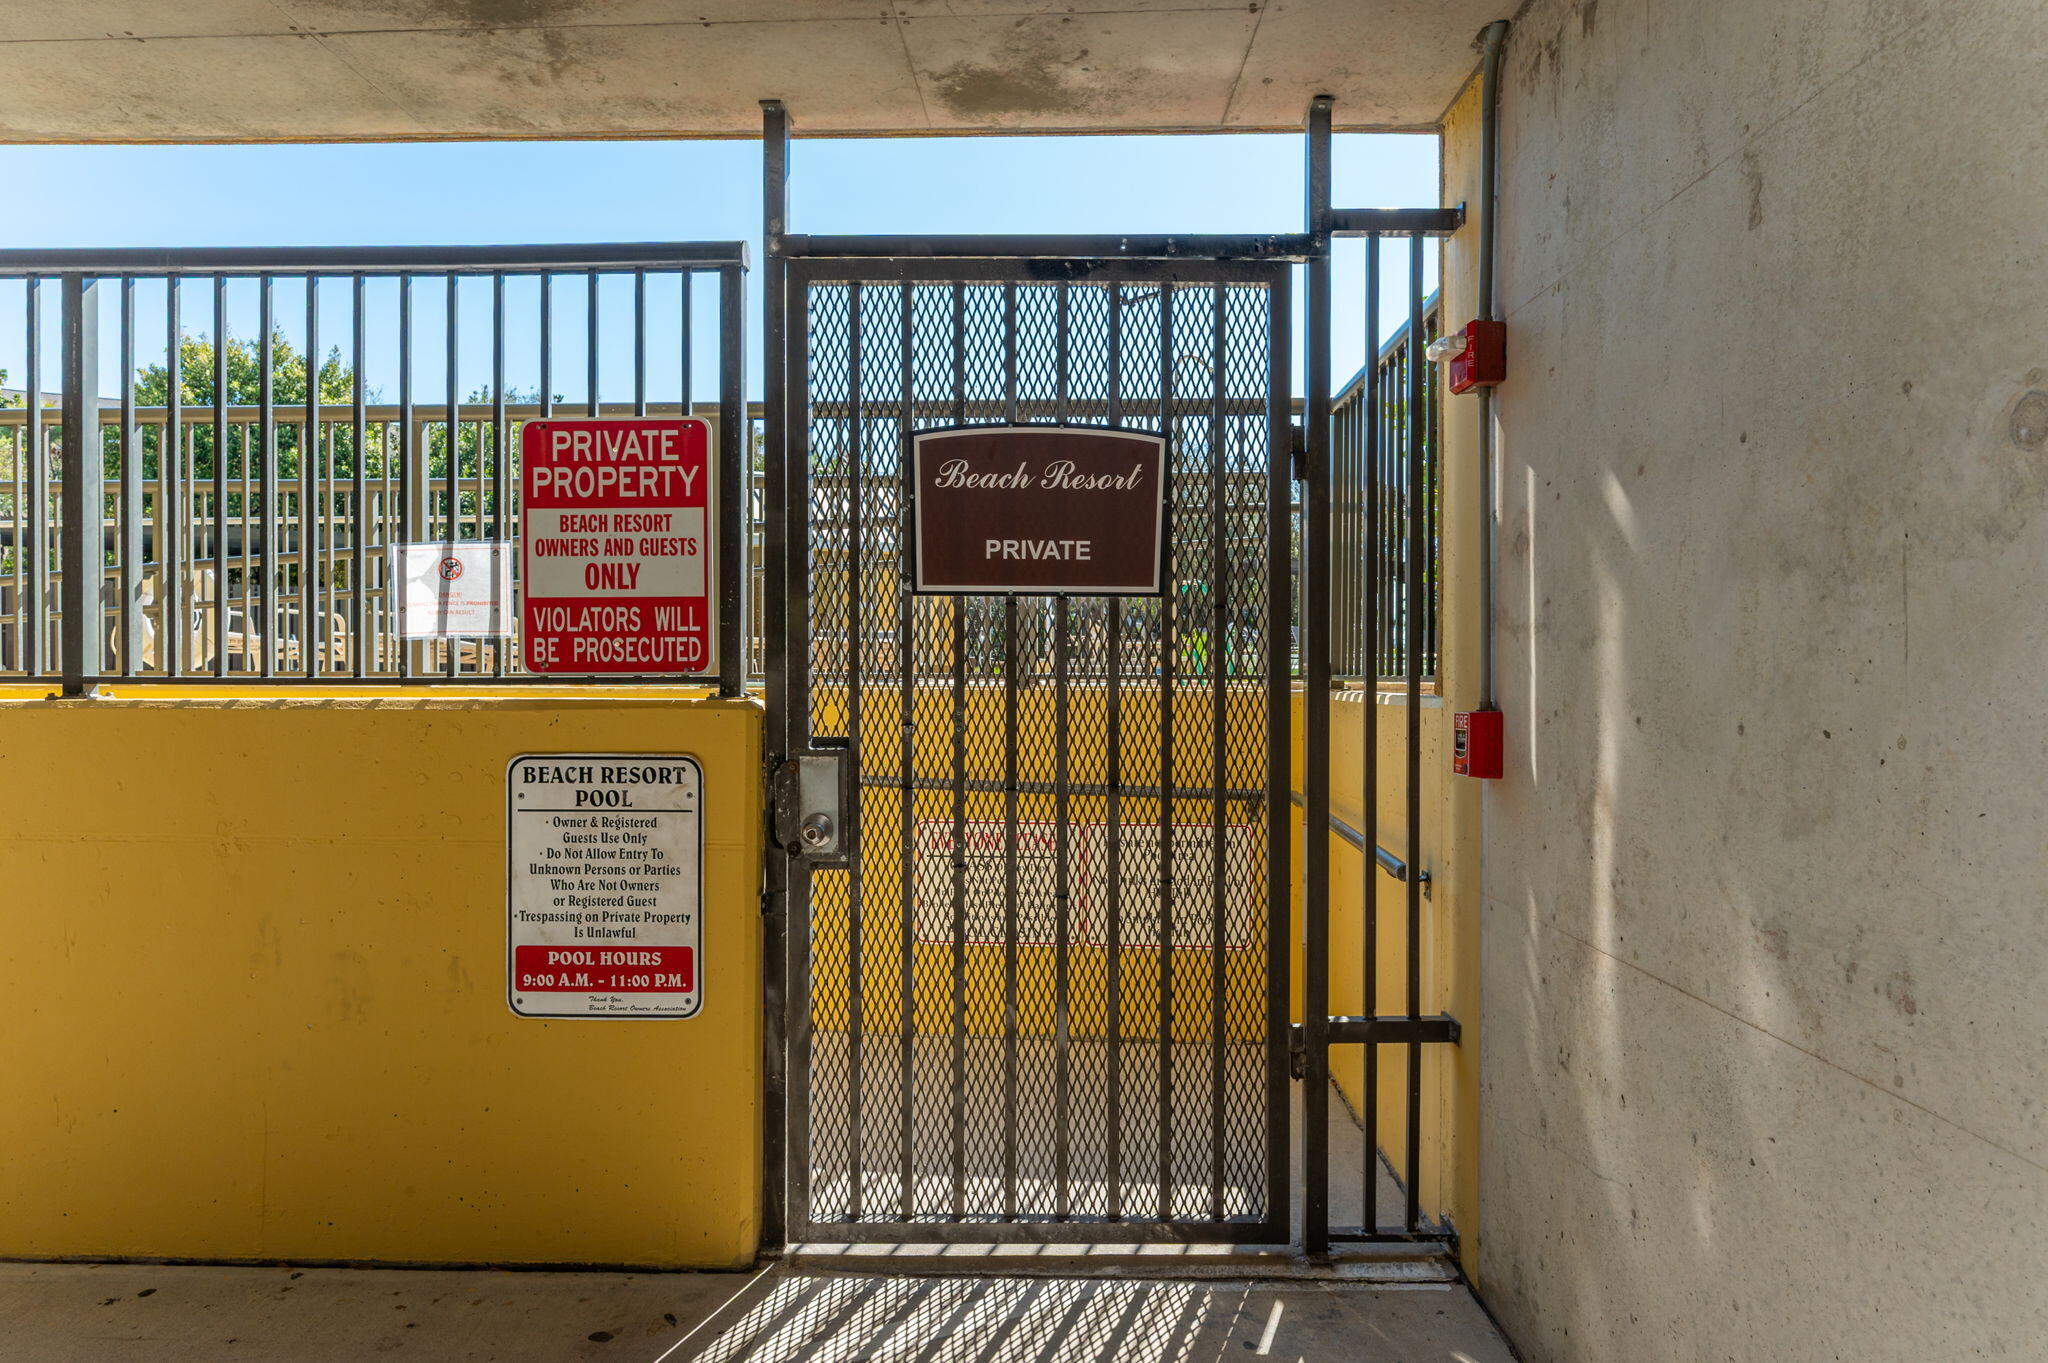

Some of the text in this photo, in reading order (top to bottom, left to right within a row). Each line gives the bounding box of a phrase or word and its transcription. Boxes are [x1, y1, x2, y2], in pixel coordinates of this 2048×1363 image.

[552, 430, 679, 461] PRIVATE
[533, 466, 699, 498] PROPERTY
[935, 458, 1142, 490] Beach Resort
[560, 514, 672, 533] BEACH RESORT
[535, 537, 697, 557] OWNERS AND GUESTS
[986, 540, 1091, 560] PRIVATE
[585, 563, 640, 590] ONLY
[534, 606, 701, 632] VIOLATORS WILL
[534, 637, 701, 662] BE PROSECUTED
[1455, 715, 1468, 728] FIRE
[523, 766, 686, 784] BEACH RESORT
[576, 790, 632, 808] POOL
[553, 817, 657, 830] Owner & Registered
[563, 832, 647, 846] Guests Use Only
[546, 848, 663, 862] Do Not Allow Entry To
[530, 865, 680, 875] Unknown Persons or Parties
[550, 880, 659, 891] Who Are Not Owners
[553, 896, 656, 909] or Registered Guest
[520, 911, 690, 925] Trespassing on Private Property
[574, 927, 636, 938] Is Unlawful
[548, 952, 662, 966] POOL HOURS
[523, 974, 554, 987] 9:00
[558, 974, 593, 987] A.M.
[611, 974, 649, 987] 11:00
[654, 974, 686, 987] P.M.
